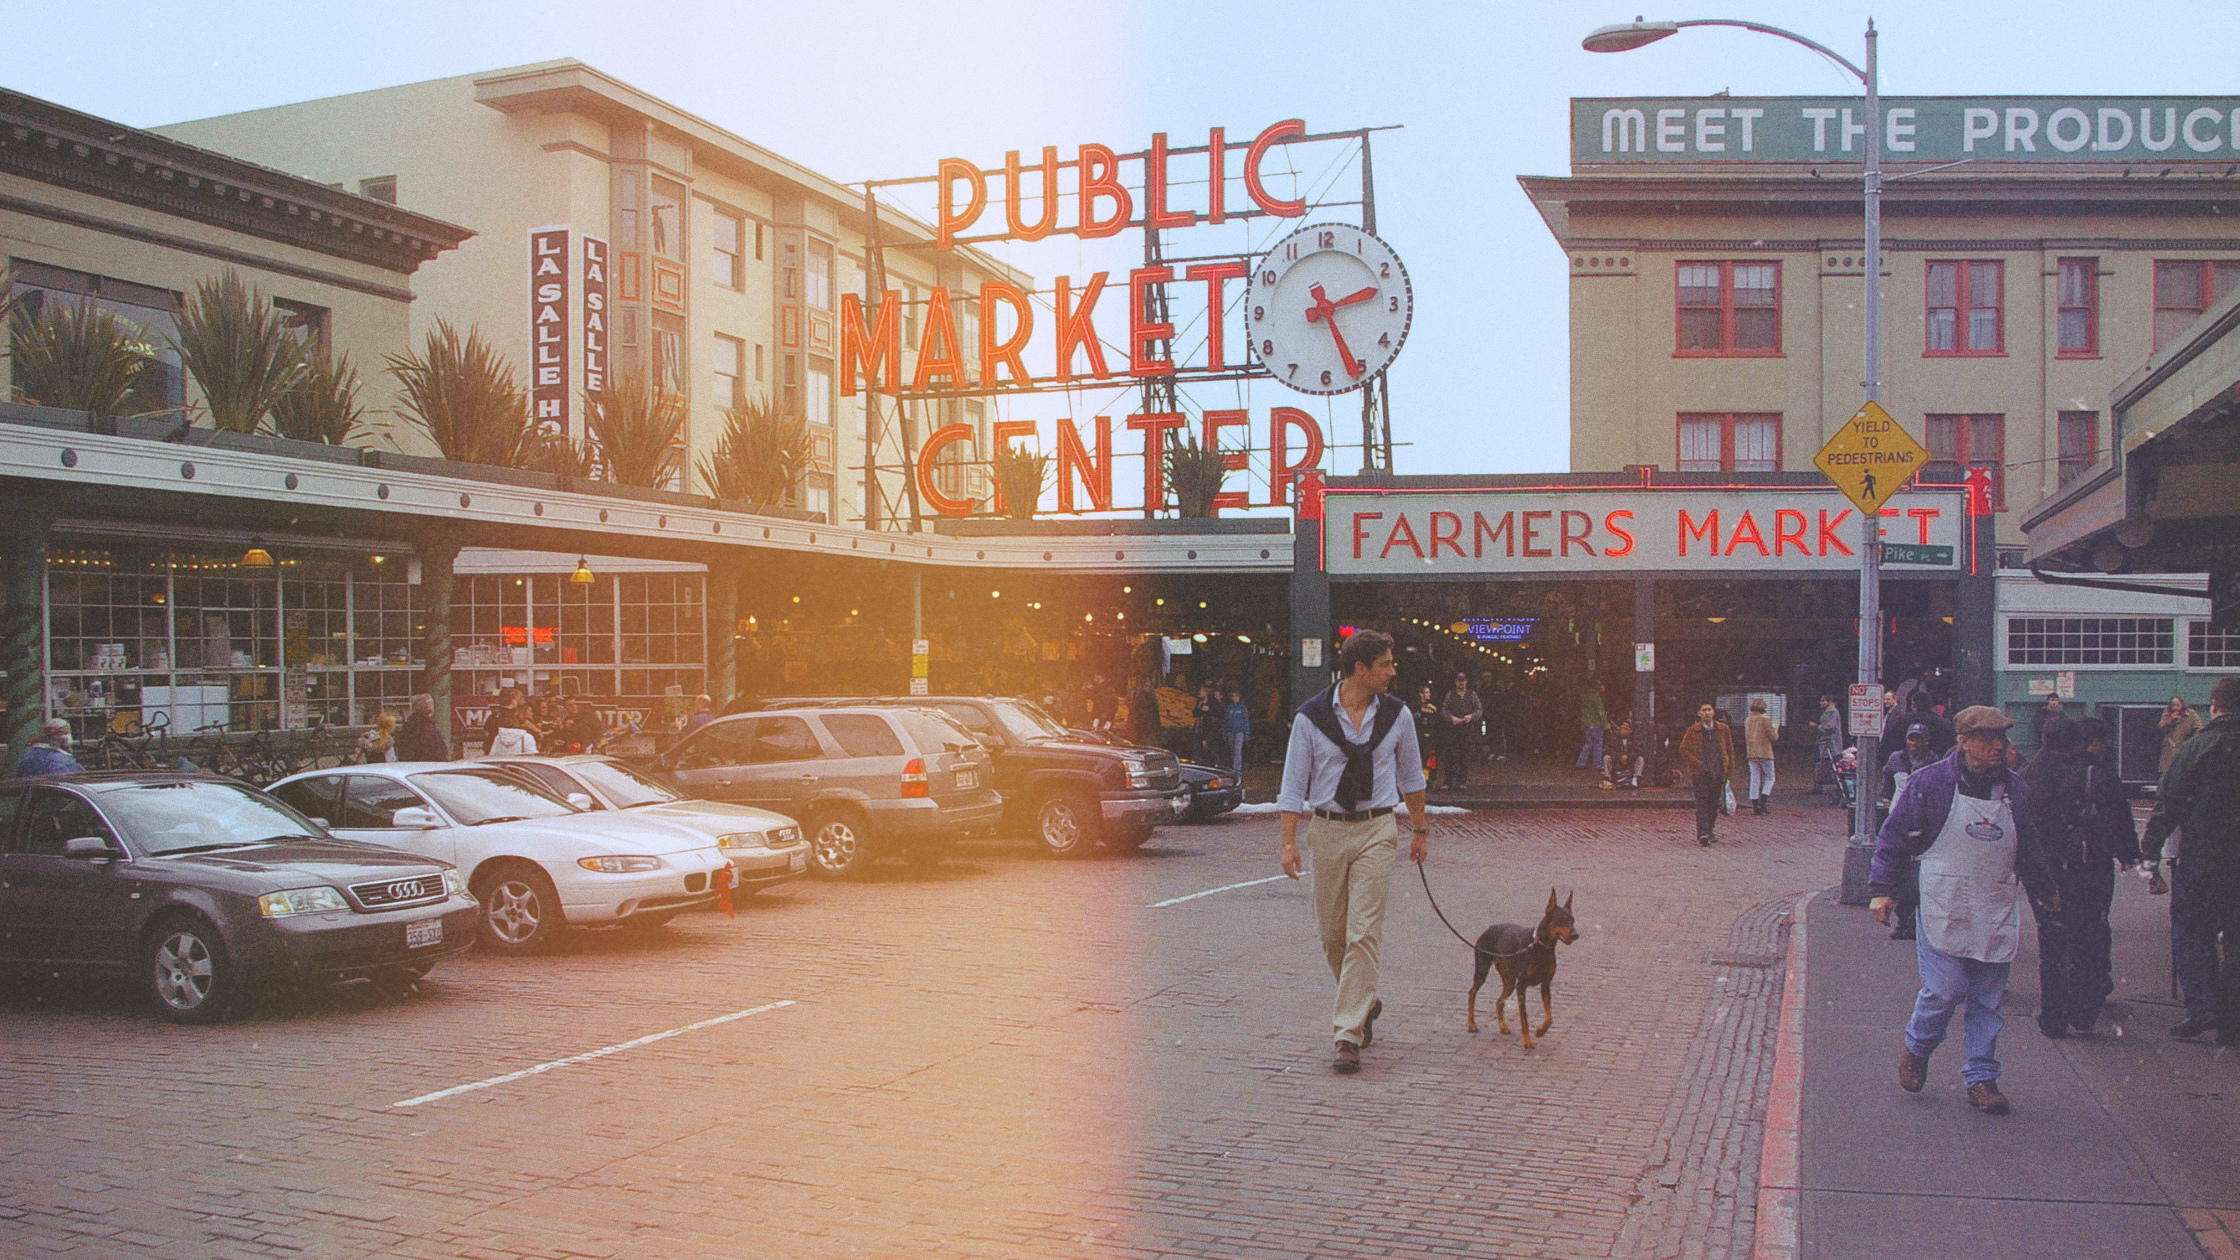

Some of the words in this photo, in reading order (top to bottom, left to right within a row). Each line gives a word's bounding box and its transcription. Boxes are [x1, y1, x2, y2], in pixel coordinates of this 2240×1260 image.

[1602, 107, 1764, 153] MEET
[1802, 107, 1916, 153] THE
[936, 118, 1306, 251] PUBLIC
[1318, 231, 1335, 249] 12
[536, 237, 561, 276] LA
[1286, 243, 1298, 261] 11
[587, 241, 604, 283] LA
[1380, 262, 1390, 279] 2
[1262, 270, 1276, 287] 10
[1388, 296, 1399, 312] 3
[1254, 306, 1264, 321] 9
[536, 283, 562, 386] SALLE
[840, 260, 1251, 397] MARKET
[586, 292, 604, 392] SALLE
[1263, 339, 1274, 355] 8
[1377, 332, 1391, 349] 4
[1287, 363, 1298, 380] 7
[1320, 370, 1332, 386] 6
[1853, 420, 1890, 433] YIELD
[1863, 436, 1879, 448] TO
[917, 406, 1325, 518] CENTER
[1827, 451, 1914, 465] PEDESTRIANS
[1353, 509, 1636, 559] FARMERS
[1885, 546, 1915, 561] Pike
[1467, 624, 1532, 634] VIEWPOINT
[1851, 686, 1866, 695] NO
[1852, 698, 1880, 707] STOPS
